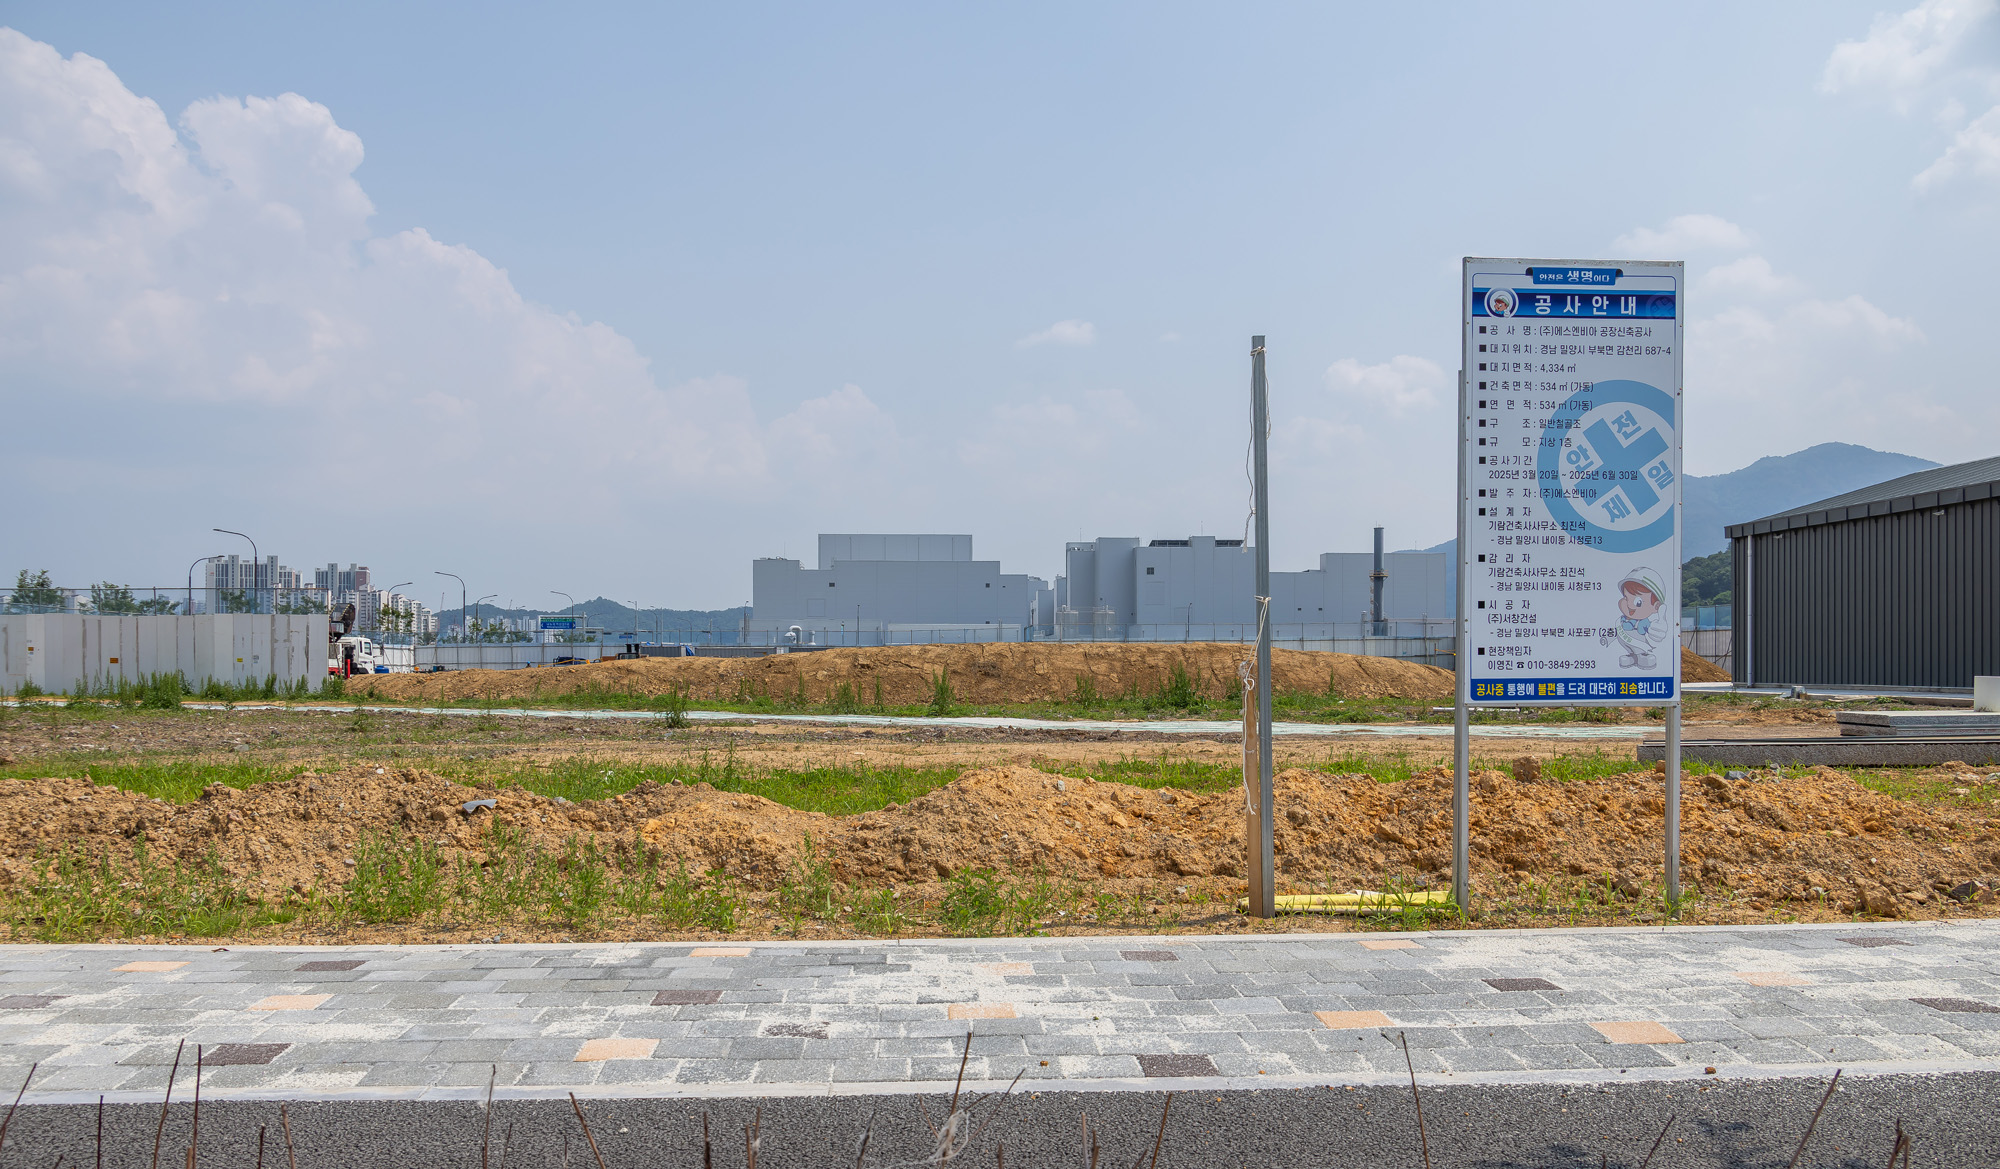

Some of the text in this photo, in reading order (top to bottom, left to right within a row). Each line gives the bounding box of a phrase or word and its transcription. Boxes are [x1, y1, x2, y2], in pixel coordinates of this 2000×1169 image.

[1566, 270, 1610, 284] 생명이다
[1539, 326, 1598, 337] (주)에스엔비아
[1600, 326, 1652, 338] 공장신축공사
[1540, 345, 1557, 355] 경남
[1560, 345, 1585, 355] 밀양시
[1588, 345, 1614, 356] 부북면
[1616, 345, 1642, 356] 감천리
[1645, 346, 1671, 356] 687-4
[1540, 364, 1565, 374] 4,334
[1540, 382, 1556, 391] 534
[1570, 381, 1594, 393] (가동)
[1539, 400, 1556, 410] 534
[1569, 400, 1593, 411] (가동)
[1538, 418, 1581, 429] 일반철골조
[1538, 437, 1556, 448] 지상
[1558, 437, 1572, 448] 1층
[1488, 470, 1520, 480] 2025년
[1522, 470, 1536, 480] 3월
[1539, 470, 1559, 480] 20일
[1569, 470, 1599, 480] 2025년
[1602, 470, 1616, 480] 6월
[1618, 470, 1638, 480] 30일
[1539, 488, 1597, 499] (주)에스엔비아
[1488, 521, 1586, 531] 기람건축사사무소 최진석
[1497, 535, 1513, 545] 경남
[1515, 535, 1539, 545] 밀양시
[1542, 535, 1566, 545] 내이동
[1568, 535, 1603, 545] 시청로13
[1488, 567, 1585, 578] 기람건축사사무소 최진석
[1496, 581, 1512, 592] 경남
[1515, 581, 1539, 592] 밀양시
[1541, 581, 1565, 592] 내이동
[1567, 581, 1602, 592] 시청로13
[1487, 613, 1537, 624] (주)서창건설
[1496, 627, 1512, 638] 경남
[1514, 627, 1539, 638] 밀양시
[1541, 627, 1565, 638] 부북면
[1567, 627, 1596, 638] 사포로7
[1598, 627, 1618, 638] (2층)
[1488, 646, 1532, 657] 현장책임자
[1488, 660, 1596, 670] 이영진 010-3849-2993
[1476, 682, 1668, 696] 공사중 통행에 불편을 드려 대단히 죄송합니다.
